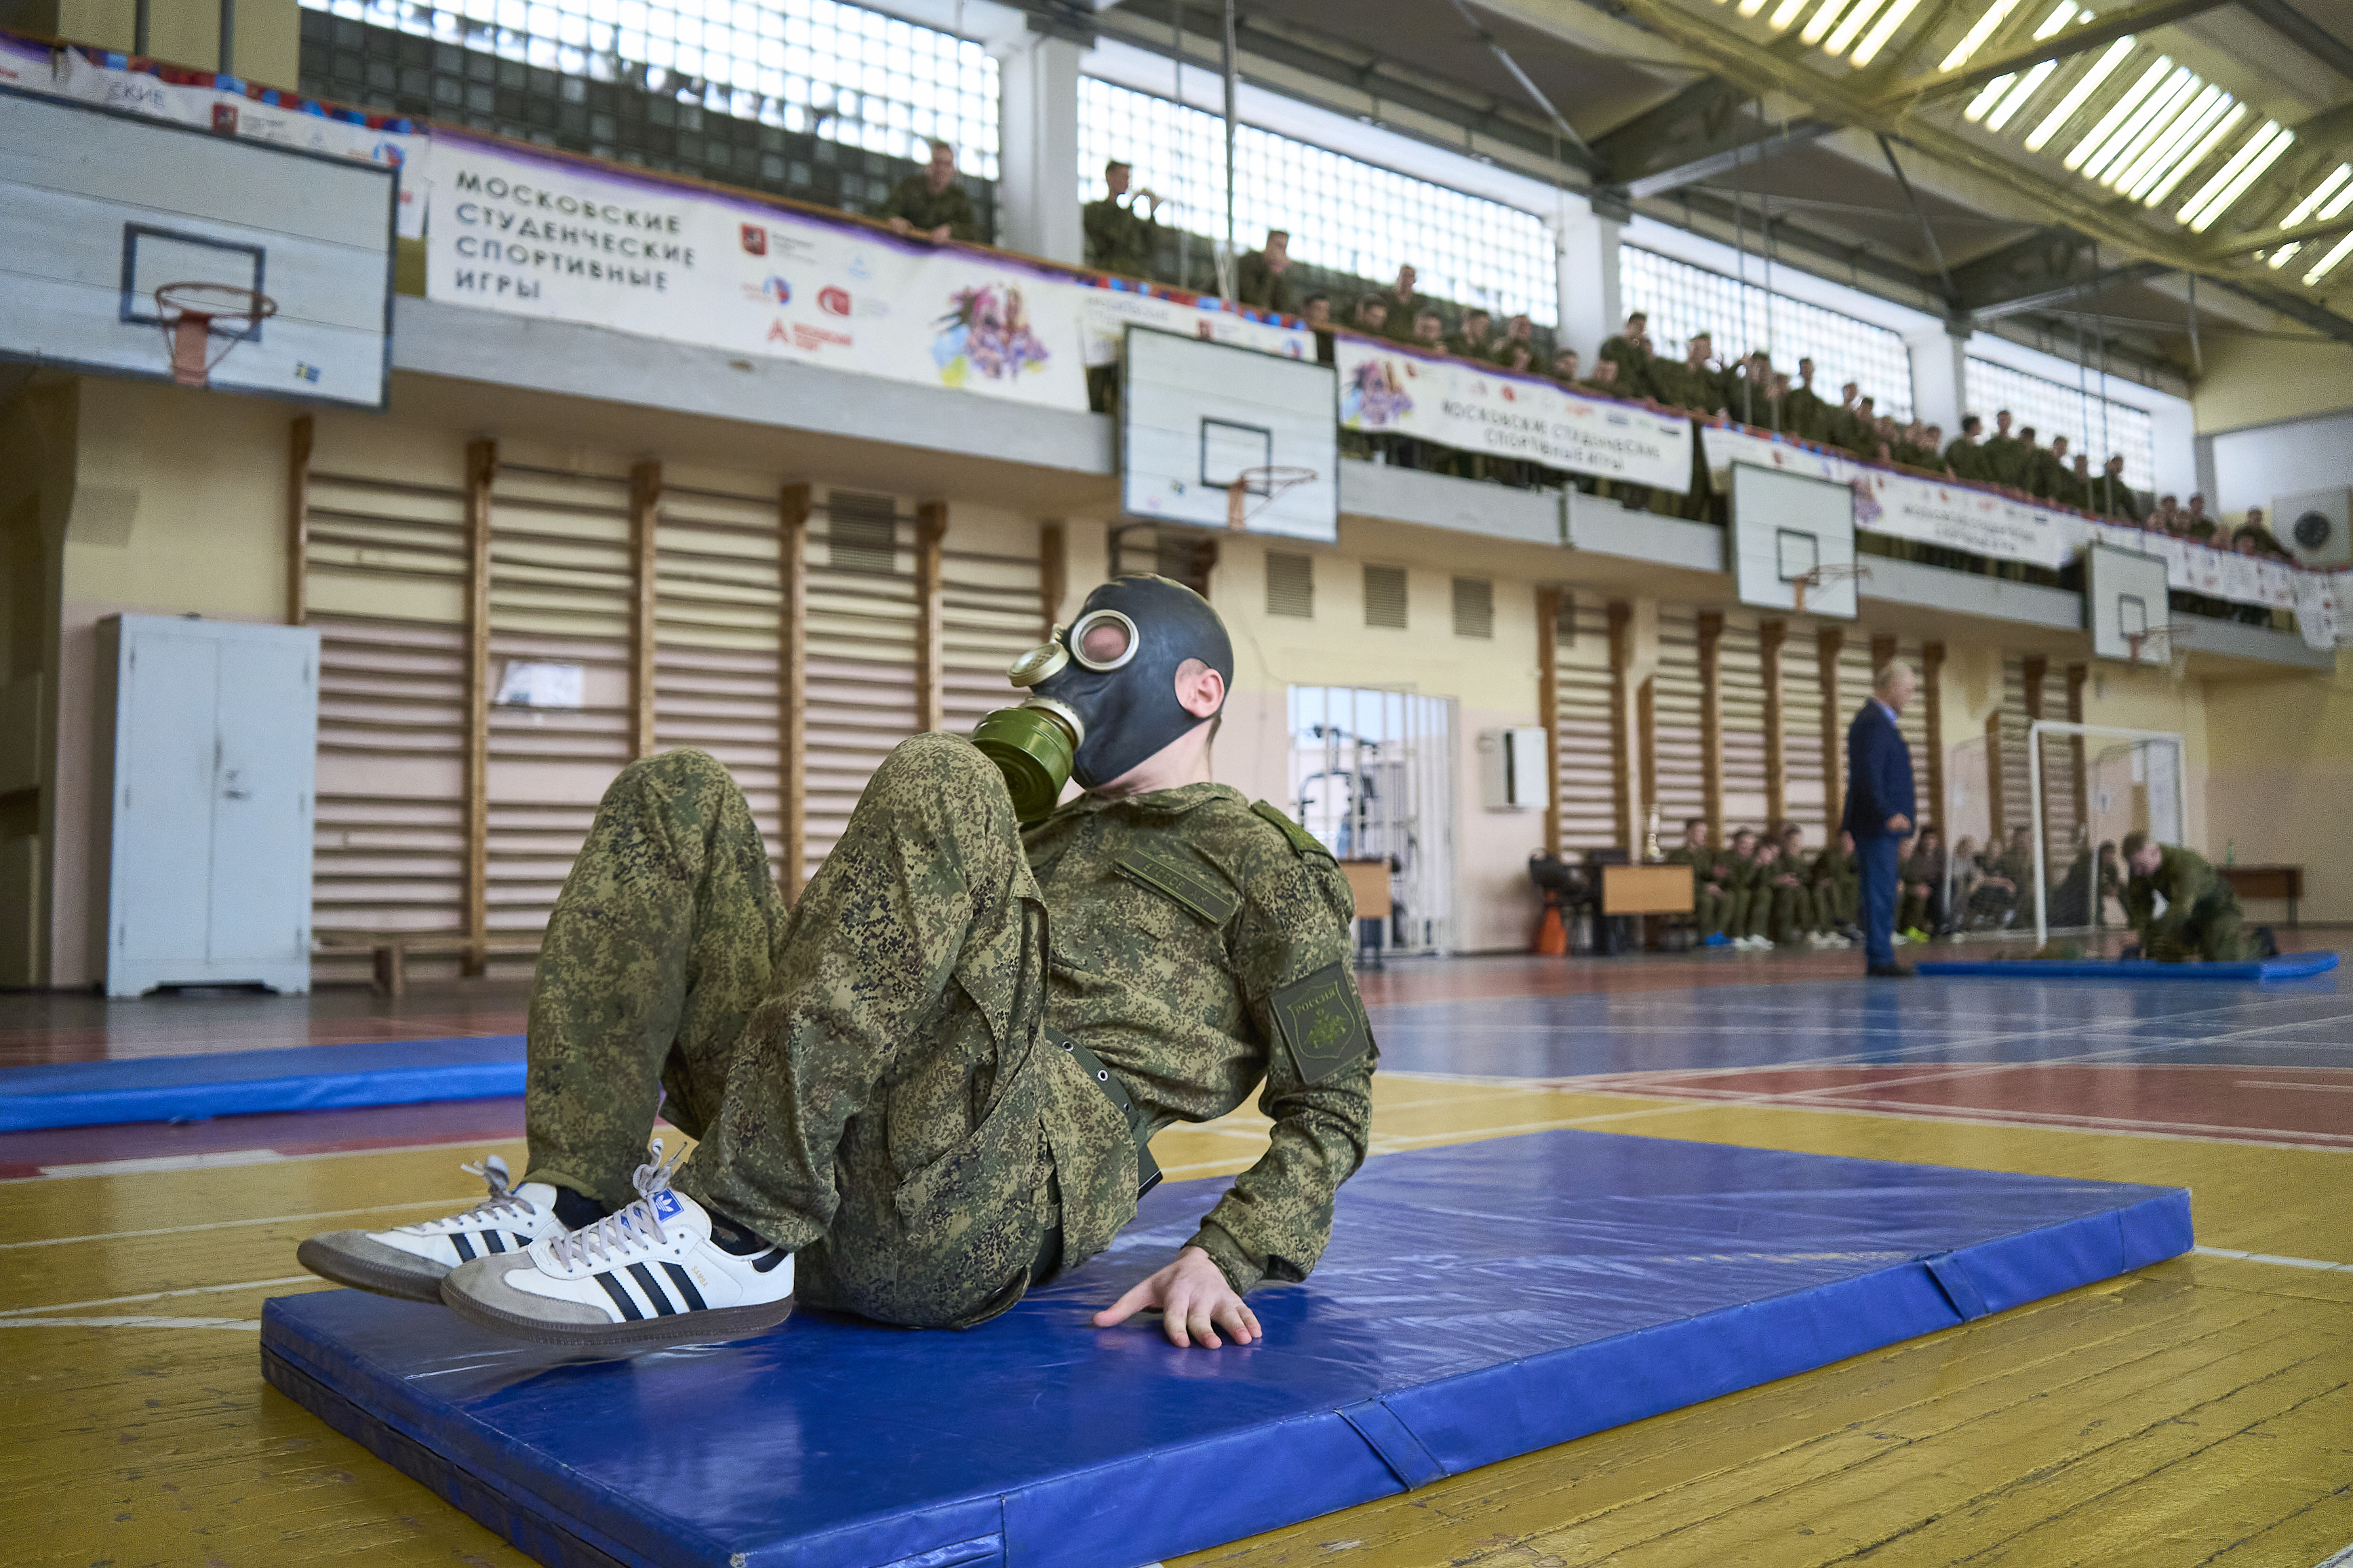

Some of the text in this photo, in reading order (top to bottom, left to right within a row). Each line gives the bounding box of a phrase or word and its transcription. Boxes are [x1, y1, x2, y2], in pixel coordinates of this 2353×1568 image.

[456, 171, 680, 233] МОСКОВСКИЕ
[456, 203, 696, 268] СТУДЕНЧЕСКИЕ
[456, 235, 669, 292] СПОРТИВНЫЕ
[456, 268, 540, 298] ИГРЫ
[1295, 988, 1337, 1015] РОССИЯ
[691, 1266, 708, 1288] SAMBA
